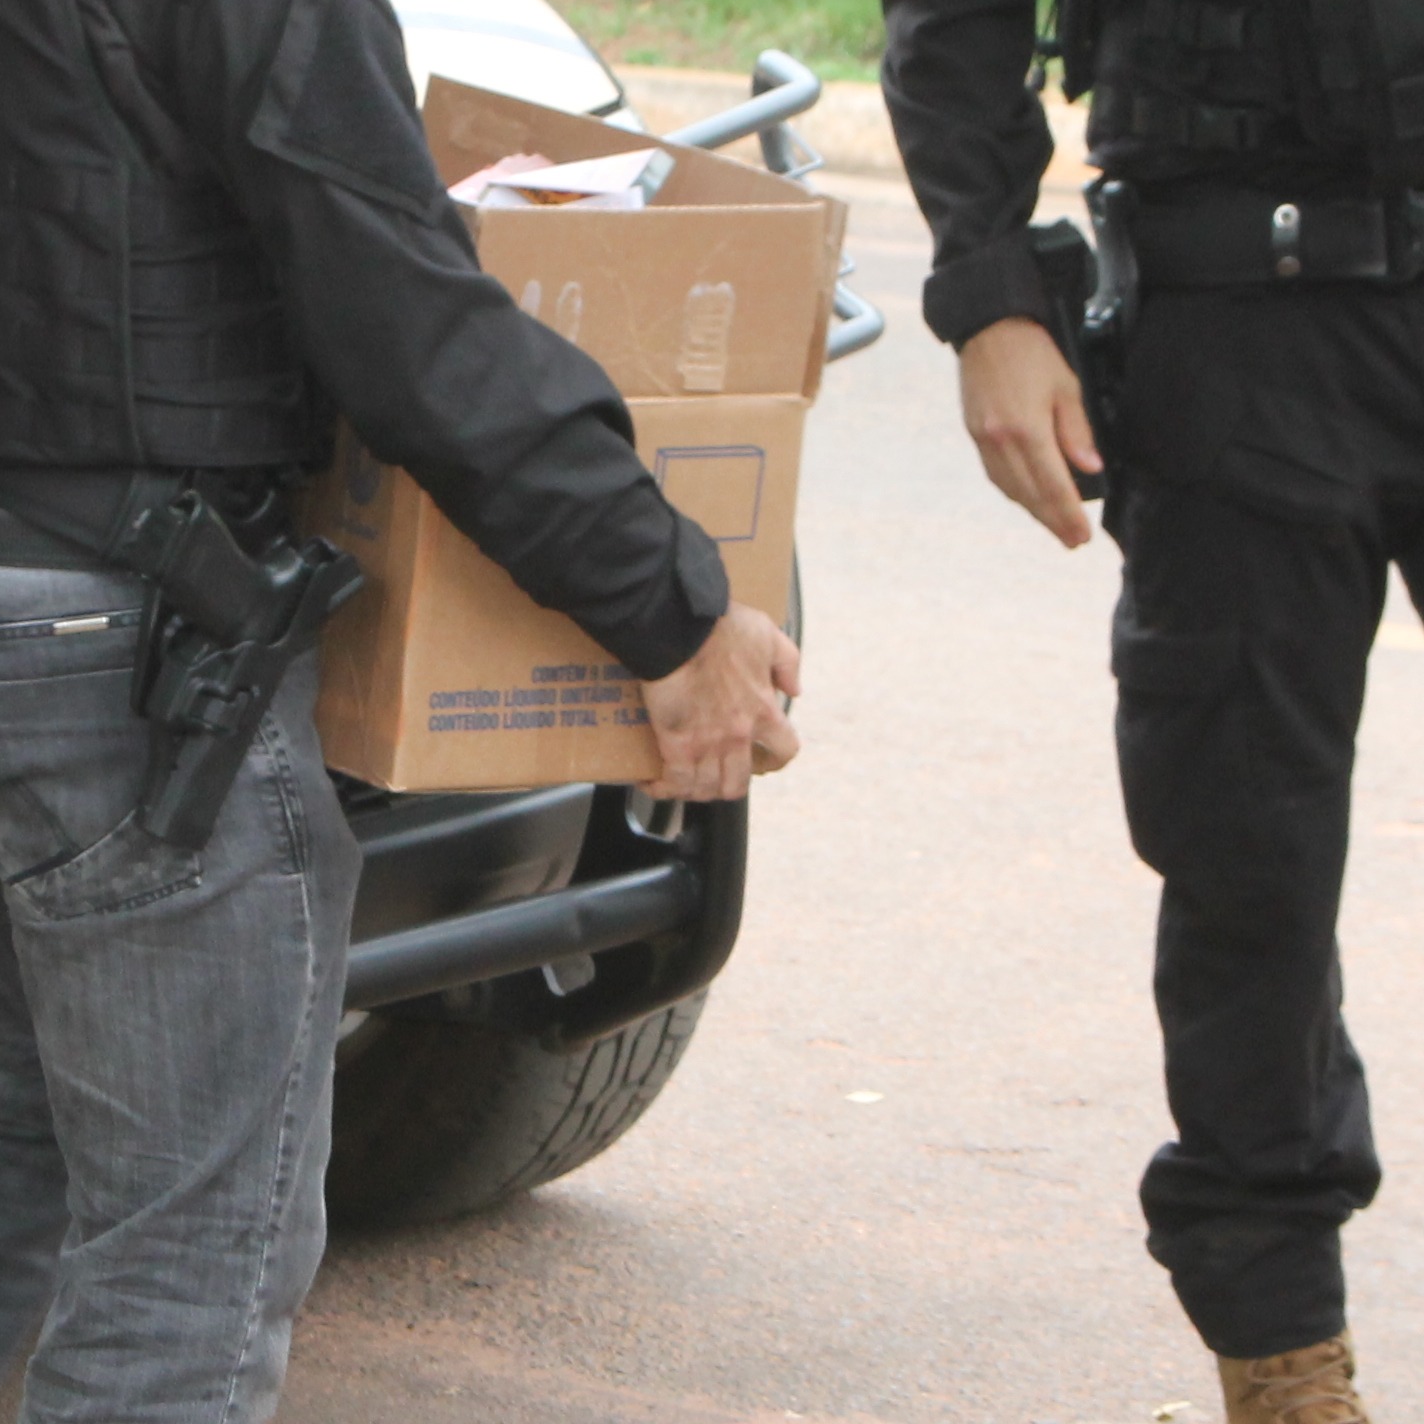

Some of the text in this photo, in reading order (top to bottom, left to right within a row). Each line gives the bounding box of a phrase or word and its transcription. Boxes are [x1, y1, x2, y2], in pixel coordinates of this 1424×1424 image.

[430, 688, 500, 709] CONTEÚDO
[505, 686, 556, 707] LÍQUIDO
[560, 684, 621, 704] UNITÁRIO
[429, 712, 499, 732] CONTEÚDO
[504, 709, 555, 729] LÍQUIDO
[560, 709, 598, 727] TOTAL
